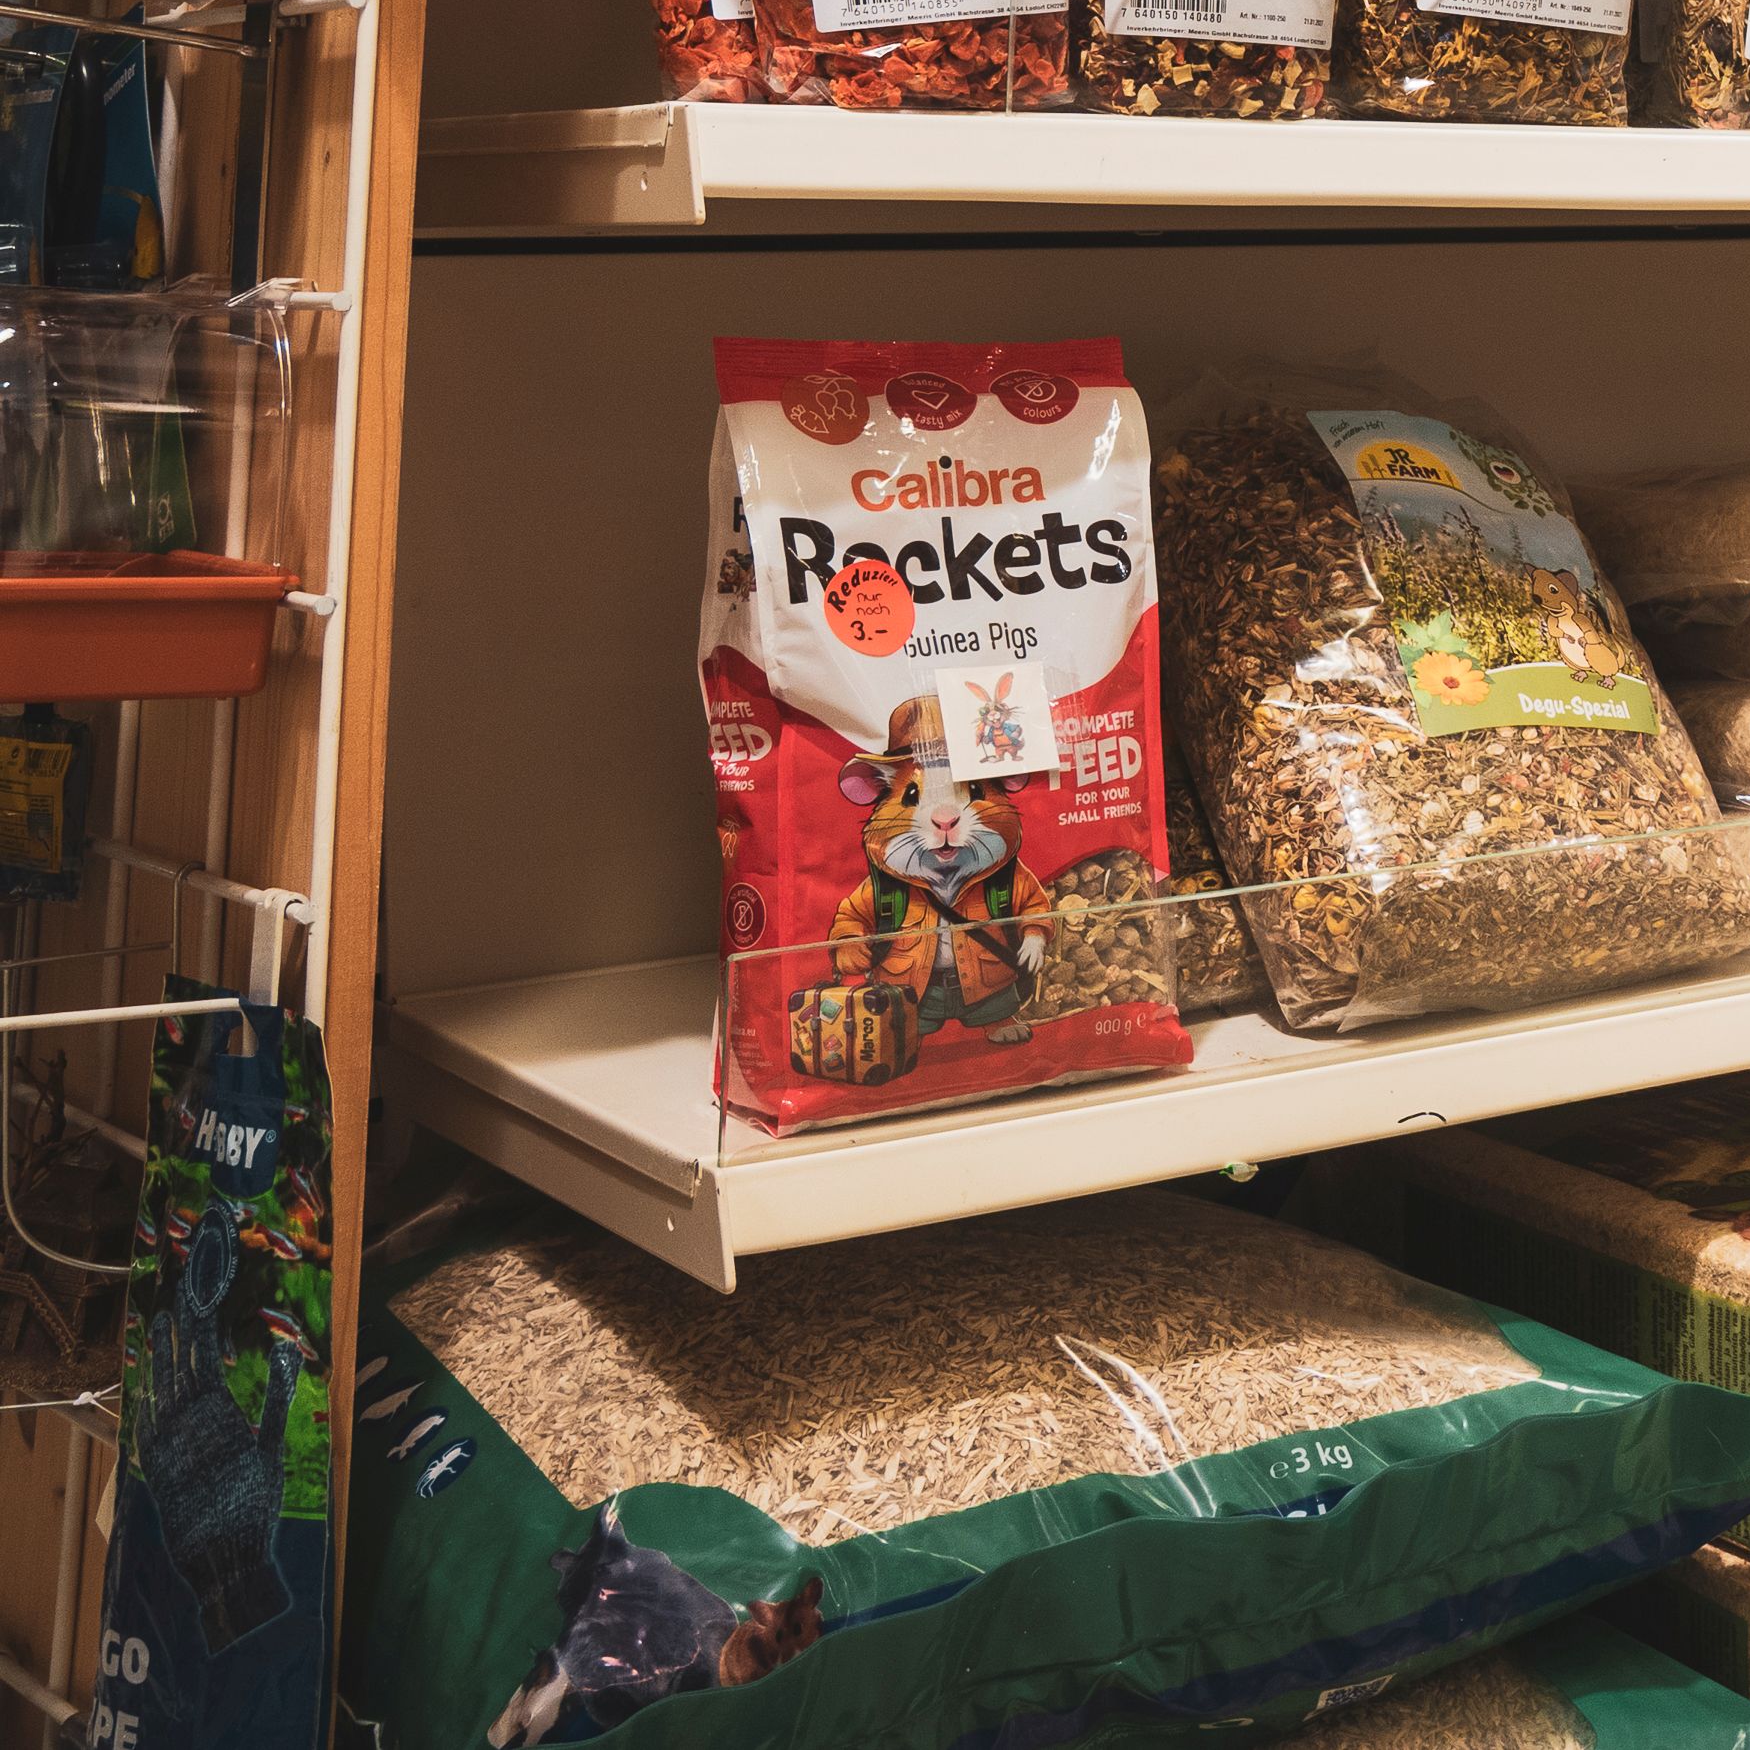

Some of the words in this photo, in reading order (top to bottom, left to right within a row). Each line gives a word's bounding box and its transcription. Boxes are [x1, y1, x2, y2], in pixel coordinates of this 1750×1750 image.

[1121, 7, 1127, 17] 7
[1134, 9, 1178, 21] 640150
[1183, 11, 1222, 23] 140480
[1023, 403, 1061, 419] colours
[1383, 447, 1412, 466] JR
[1387, 458, 1441, 481] FARM
[850, 455, 1046, 512] Calibra
[827, 568, 899, 613] Reduziert
[856, 591, 882, 603] nur
[856, 604, 890, 616] noch
[1517, 692, 1630, 721] Degu-Spezial
[1053, 710, 1135, 742] COMPLETE
[720, 778, 755, 793] FRIENDS
[1075, 792, 1097, 806] FOR
[1101, 785, 1130, 802] YOUR
[1058, 808, 1101, 826] SMALL
[1104, 800, 1142, 820] FRIENDS
[1095, 1019, 1121, 1035] 900
[1124, 1019, 1133, 1036] g
[860, 1016, 874, 1062] Marco
[1288, 1441, 1313, 1477] 3
[1316, 1438, 1357, 1474] kg
